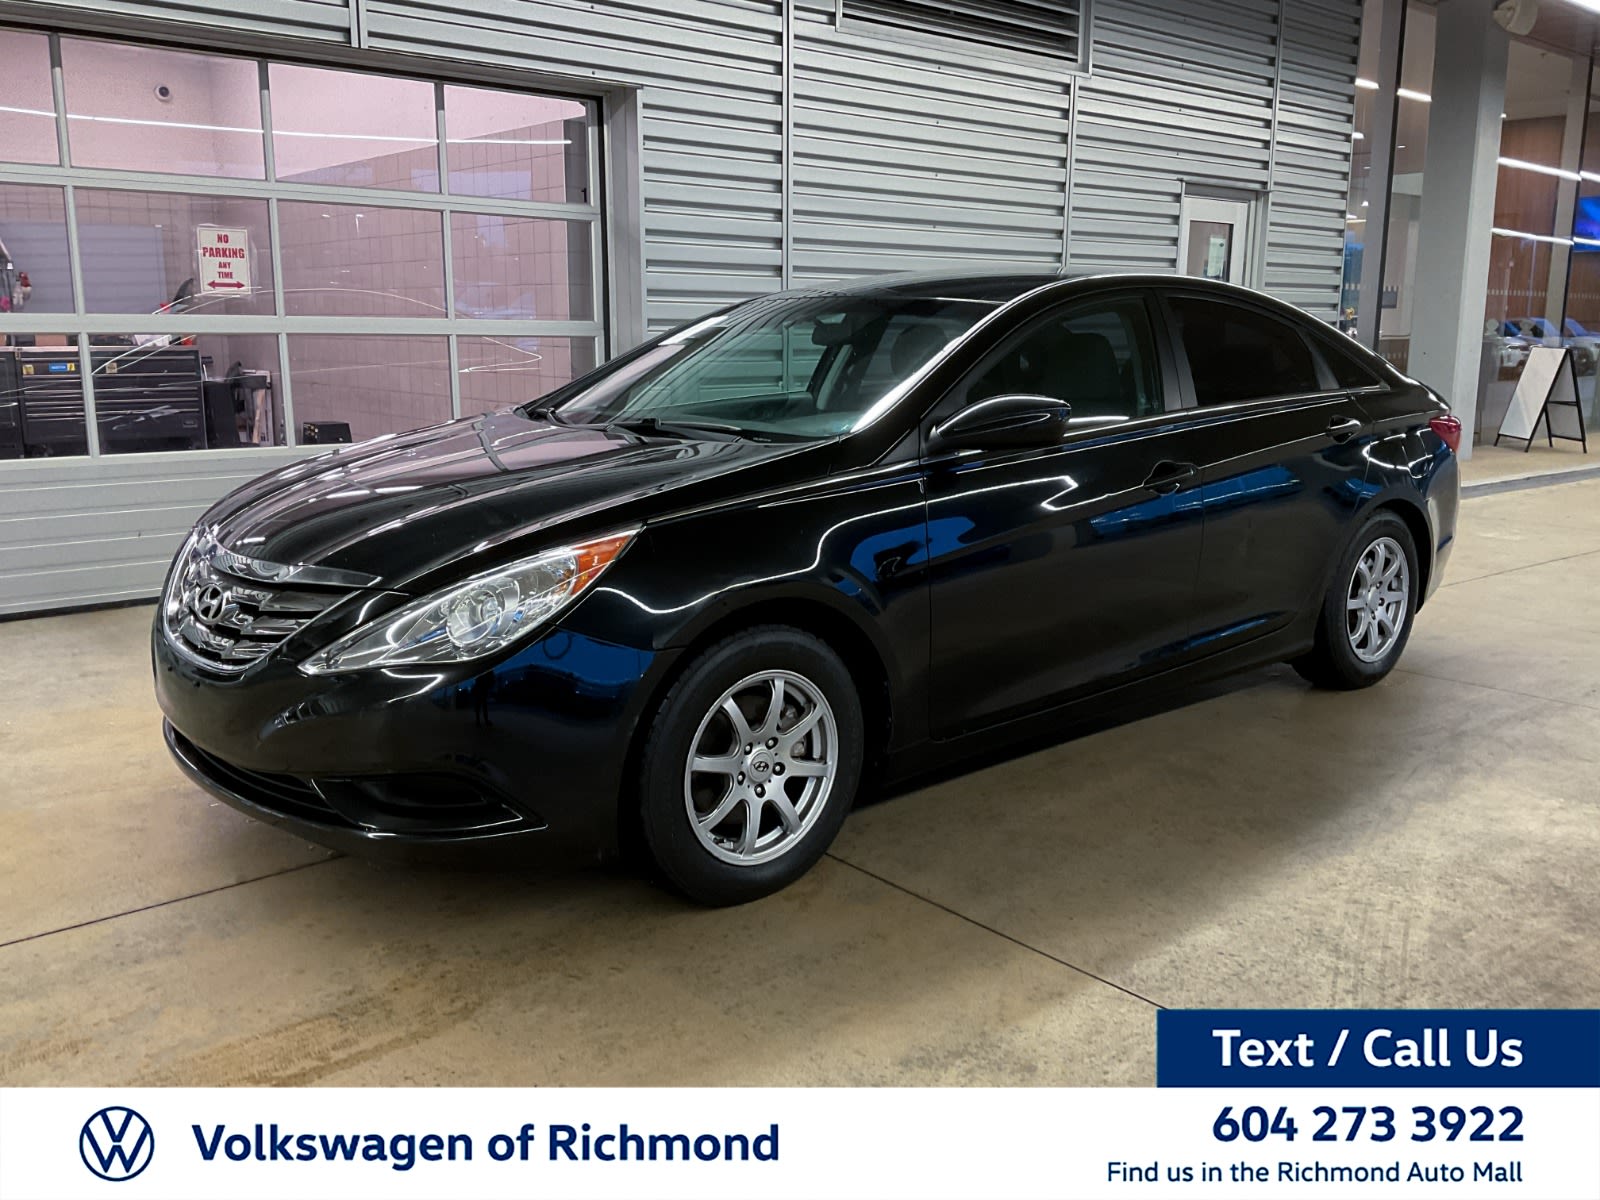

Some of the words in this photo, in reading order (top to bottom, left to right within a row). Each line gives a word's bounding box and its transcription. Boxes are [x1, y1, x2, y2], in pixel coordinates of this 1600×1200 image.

[217, 233, 229, 243] NO
[202, 246, 245, 259] PARKING
[218, 261, 231, 269] ANY
[217, 271, 233, 279] TIME
